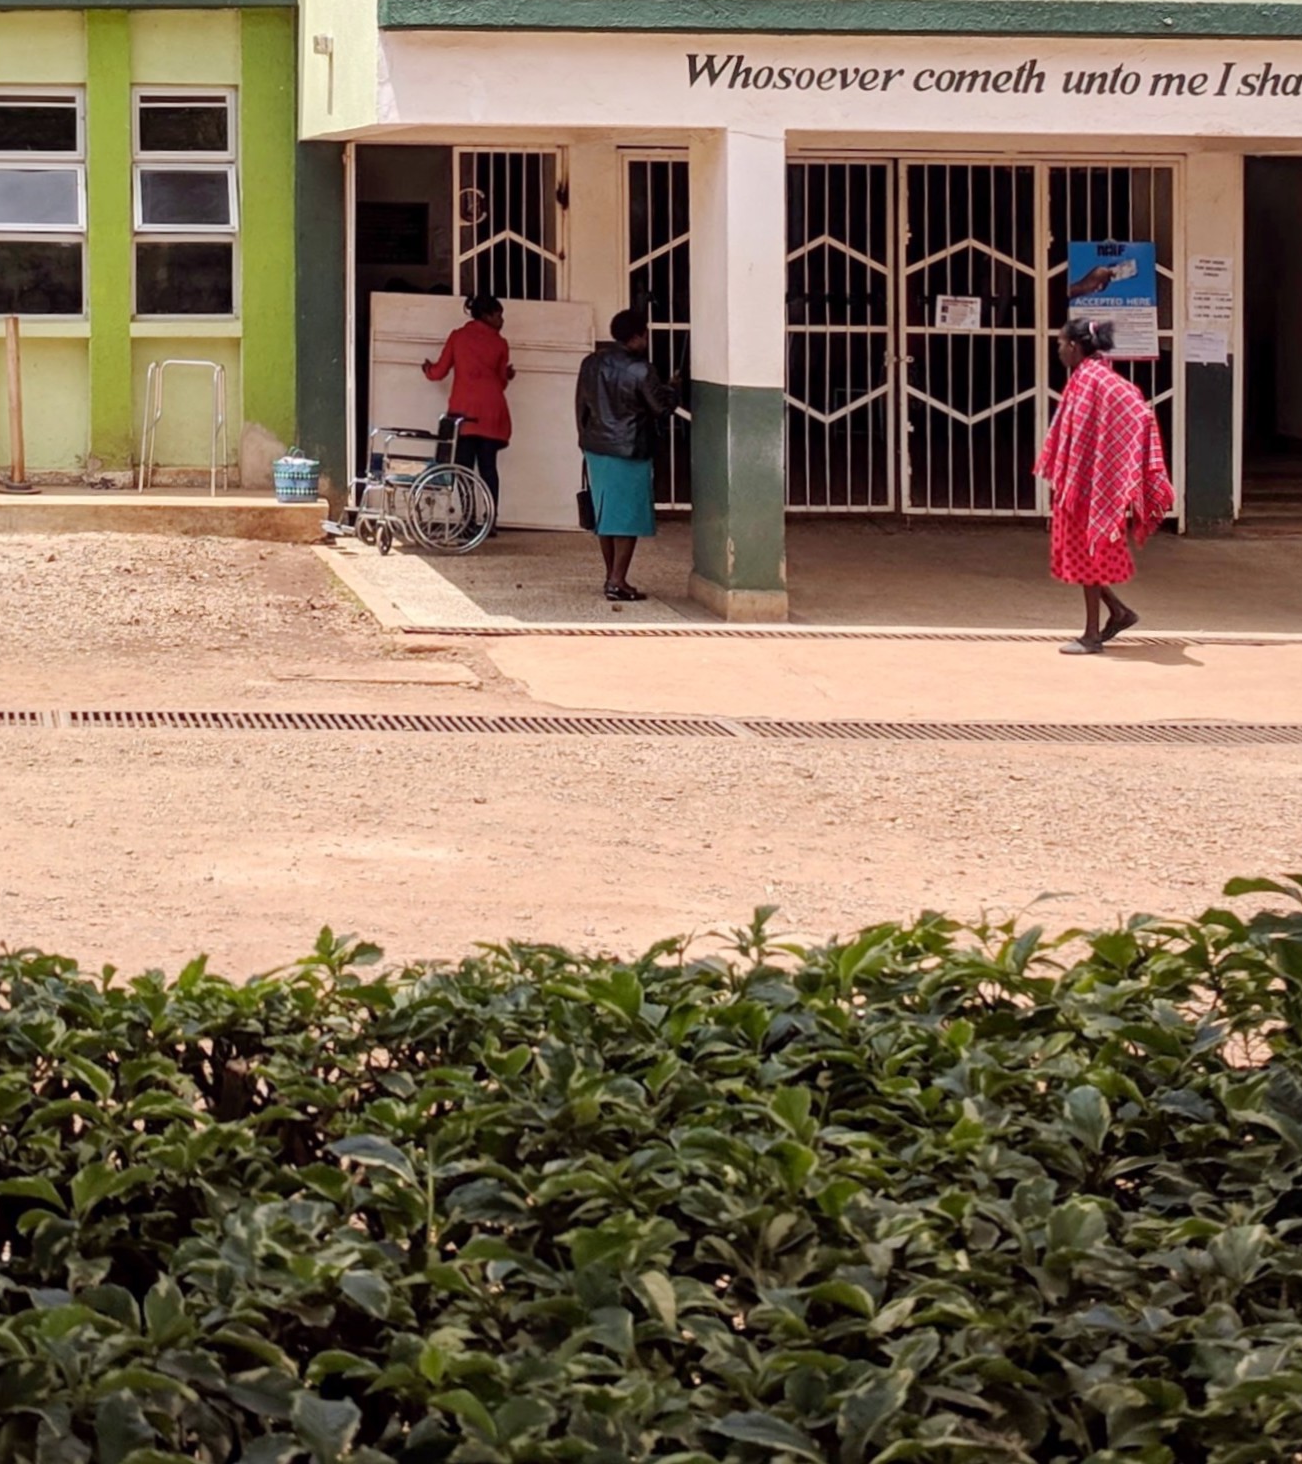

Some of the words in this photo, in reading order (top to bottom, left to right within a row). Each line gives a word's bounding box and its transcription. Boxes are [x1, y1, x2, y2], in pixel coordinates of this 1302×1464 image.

[686, 53, 905, 92] Whosoever
[913, 58, 1046, 94] cometh
[1062, 63, 1141, 95] unto
[1149, 73, 1209, 96] me
[1214, 62, 1237, 97] I
[1074, 297, 1123, 306] ACCEPTED
[1126, 297, 1152, 306] HERE
